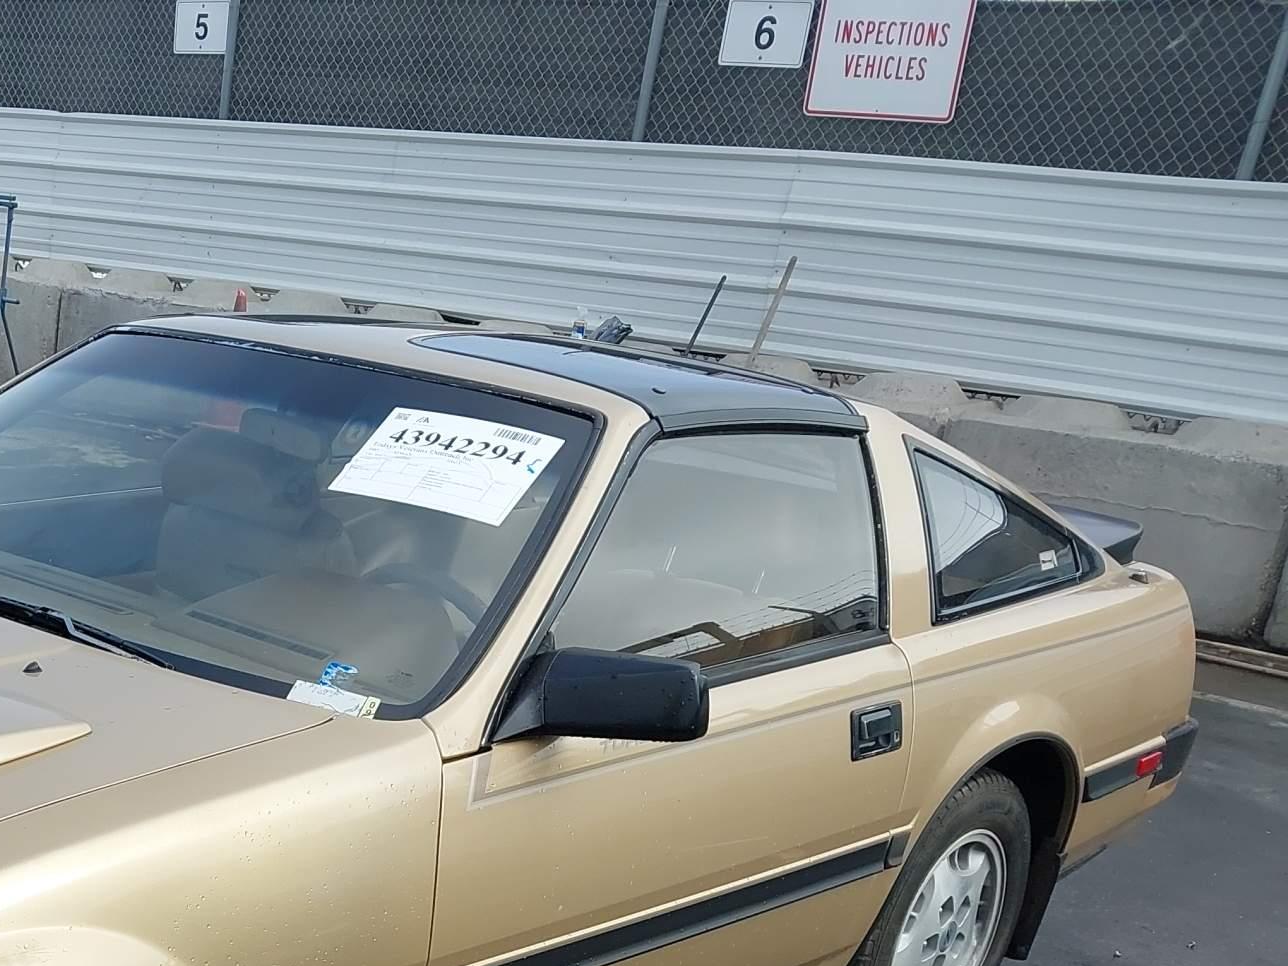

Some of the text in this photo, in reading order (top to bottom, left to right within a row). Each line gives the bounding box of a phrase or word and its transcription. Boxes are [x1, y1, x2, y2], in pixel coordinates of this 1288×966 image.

[195, 13, 209, 40] 5
[754, 16, 777, 50] 6
[834, 19, 951, 47] INSPECTIONS
[844, 54, 928, 81] VEHICLES
[389, 428, 526, 465] 43942294
